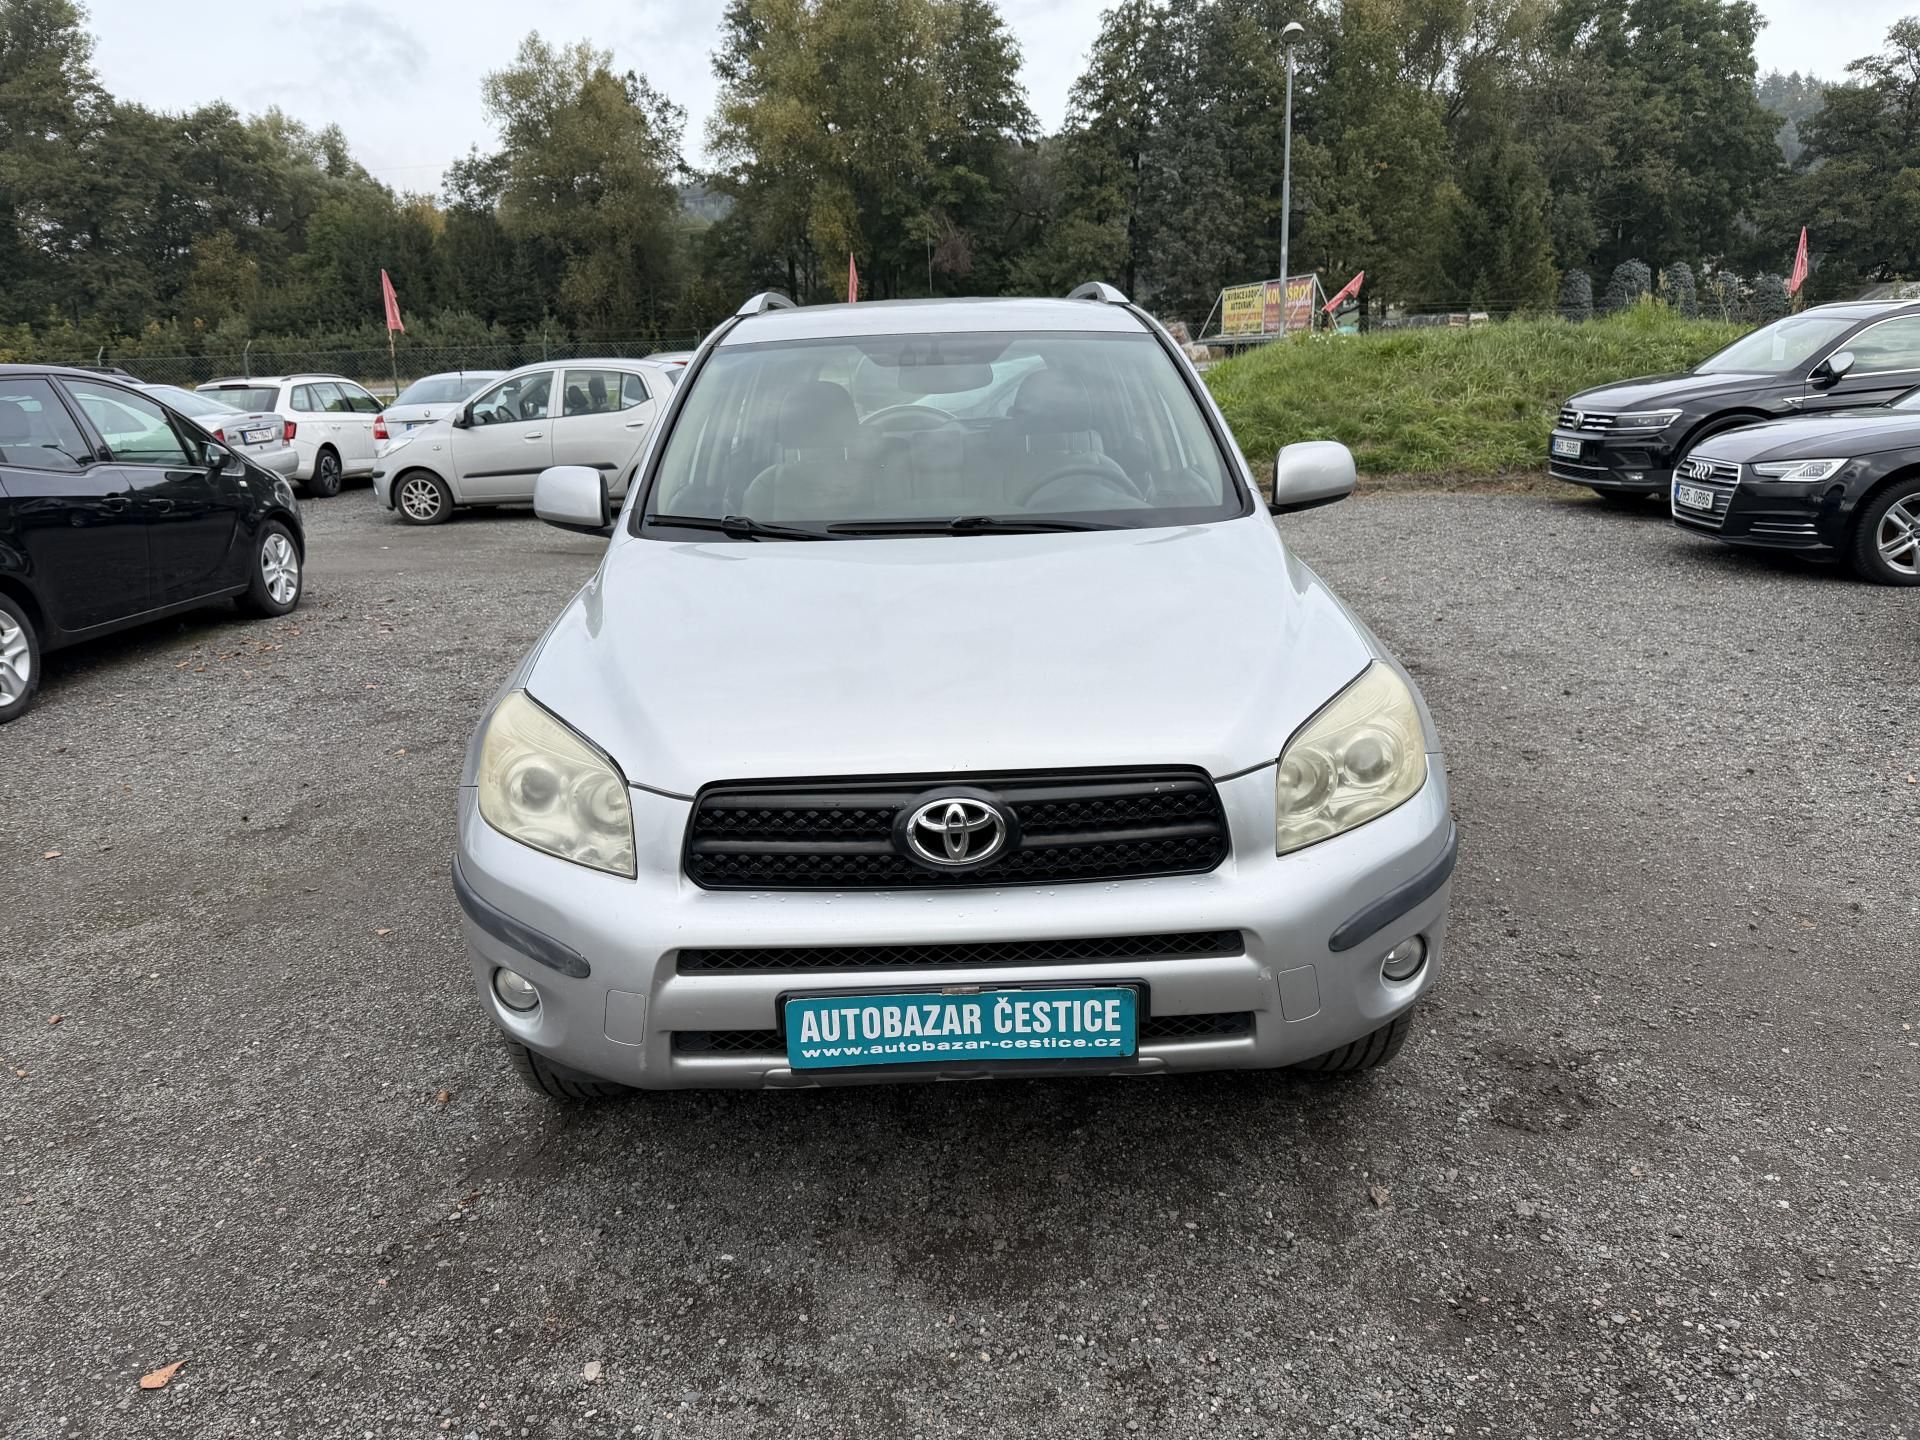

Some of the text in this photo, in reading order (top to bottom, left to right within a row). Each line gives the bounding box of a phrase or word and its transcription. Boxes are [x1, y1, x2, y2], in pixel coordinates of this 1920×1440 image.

[1266, 282, 1312, 305] KOVŠROT
[1680, 487, 1710, 506] 7H5 0886
[800, 996, 1122, 1043] AUTOBAZAR ČESTICE
[802, 1037, 1121, 1058] www.autobazar-cestice.cz
